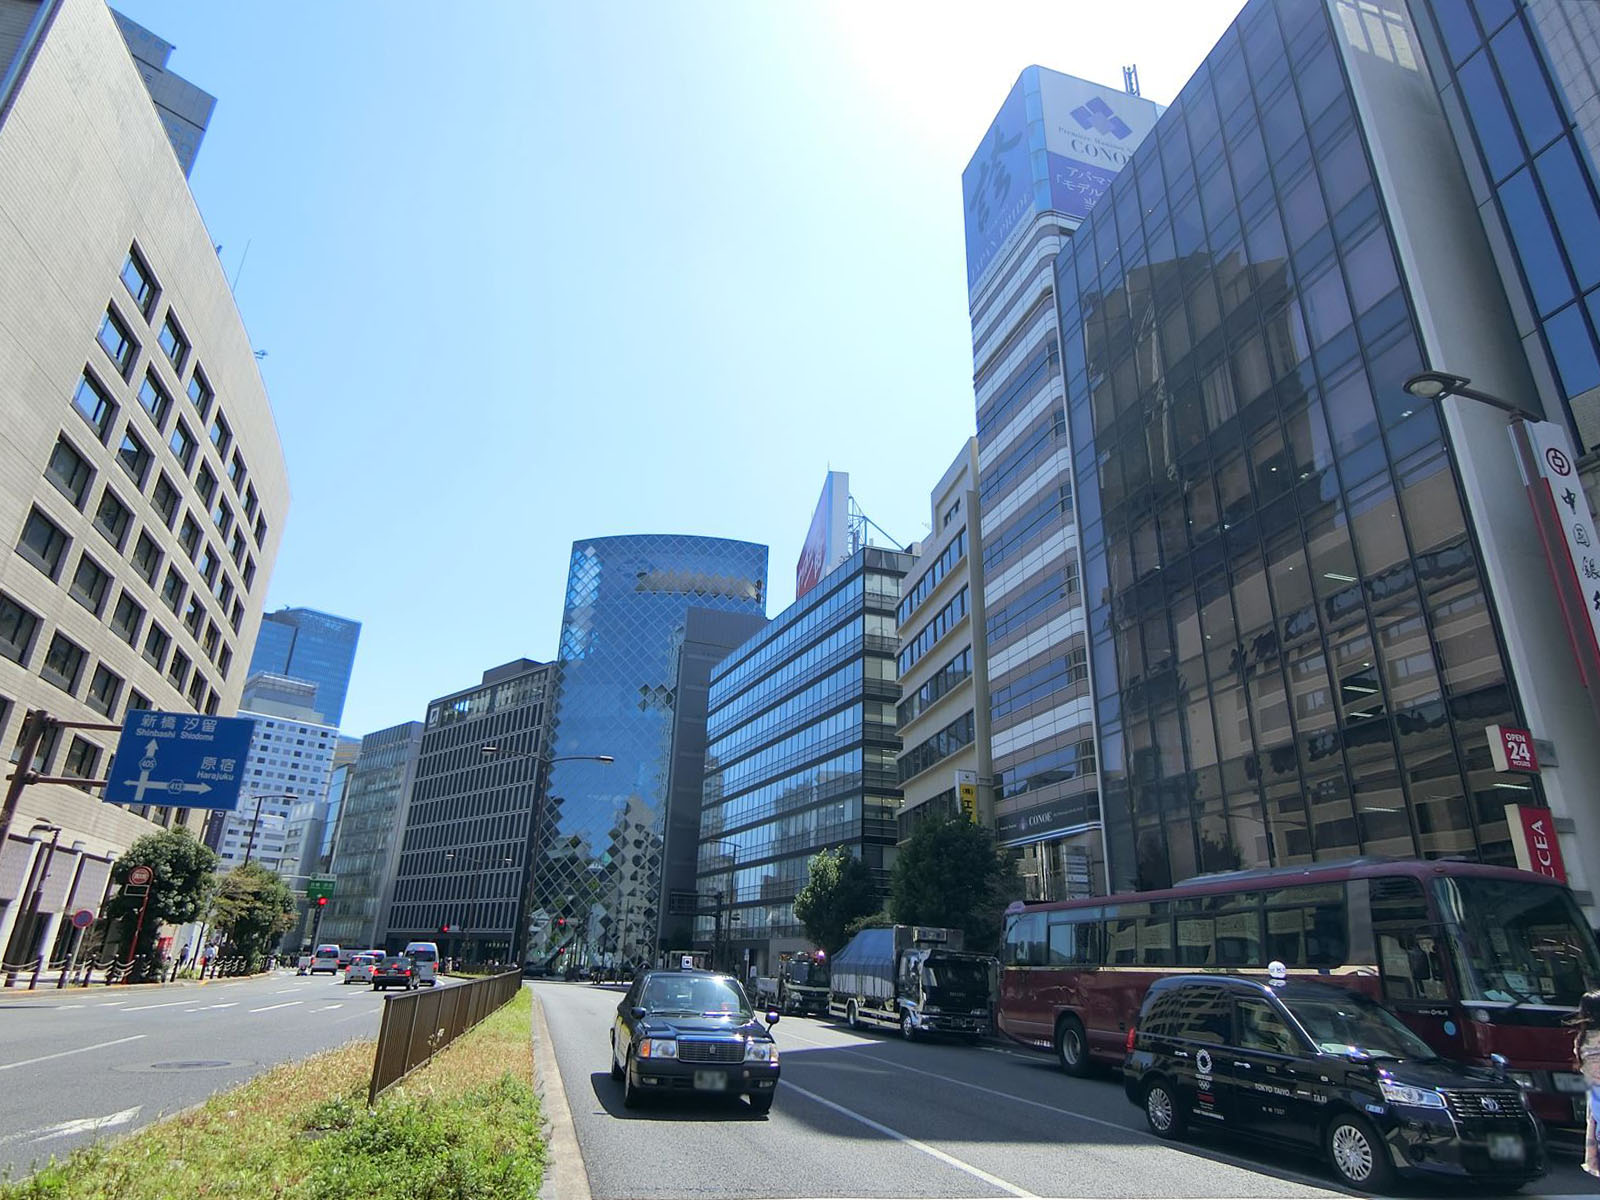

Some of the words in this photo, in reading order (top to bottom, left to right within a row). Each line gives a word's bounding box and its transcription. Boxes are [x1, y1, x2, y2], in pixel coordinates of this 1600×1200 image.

[1071, 139, 1134, 165] CONO
[141, 714, 176, 730] 新橋
[183, 717, 217, 733] 汐留
[136, 728, 176, 739] Shinbashi
[1505, 732, 1526, 743] OPEN
[1507, 741, 1530, 761] 24
[200, 756, 236, 772] 原宿
[197, 770, 234, 781] Harajuku
